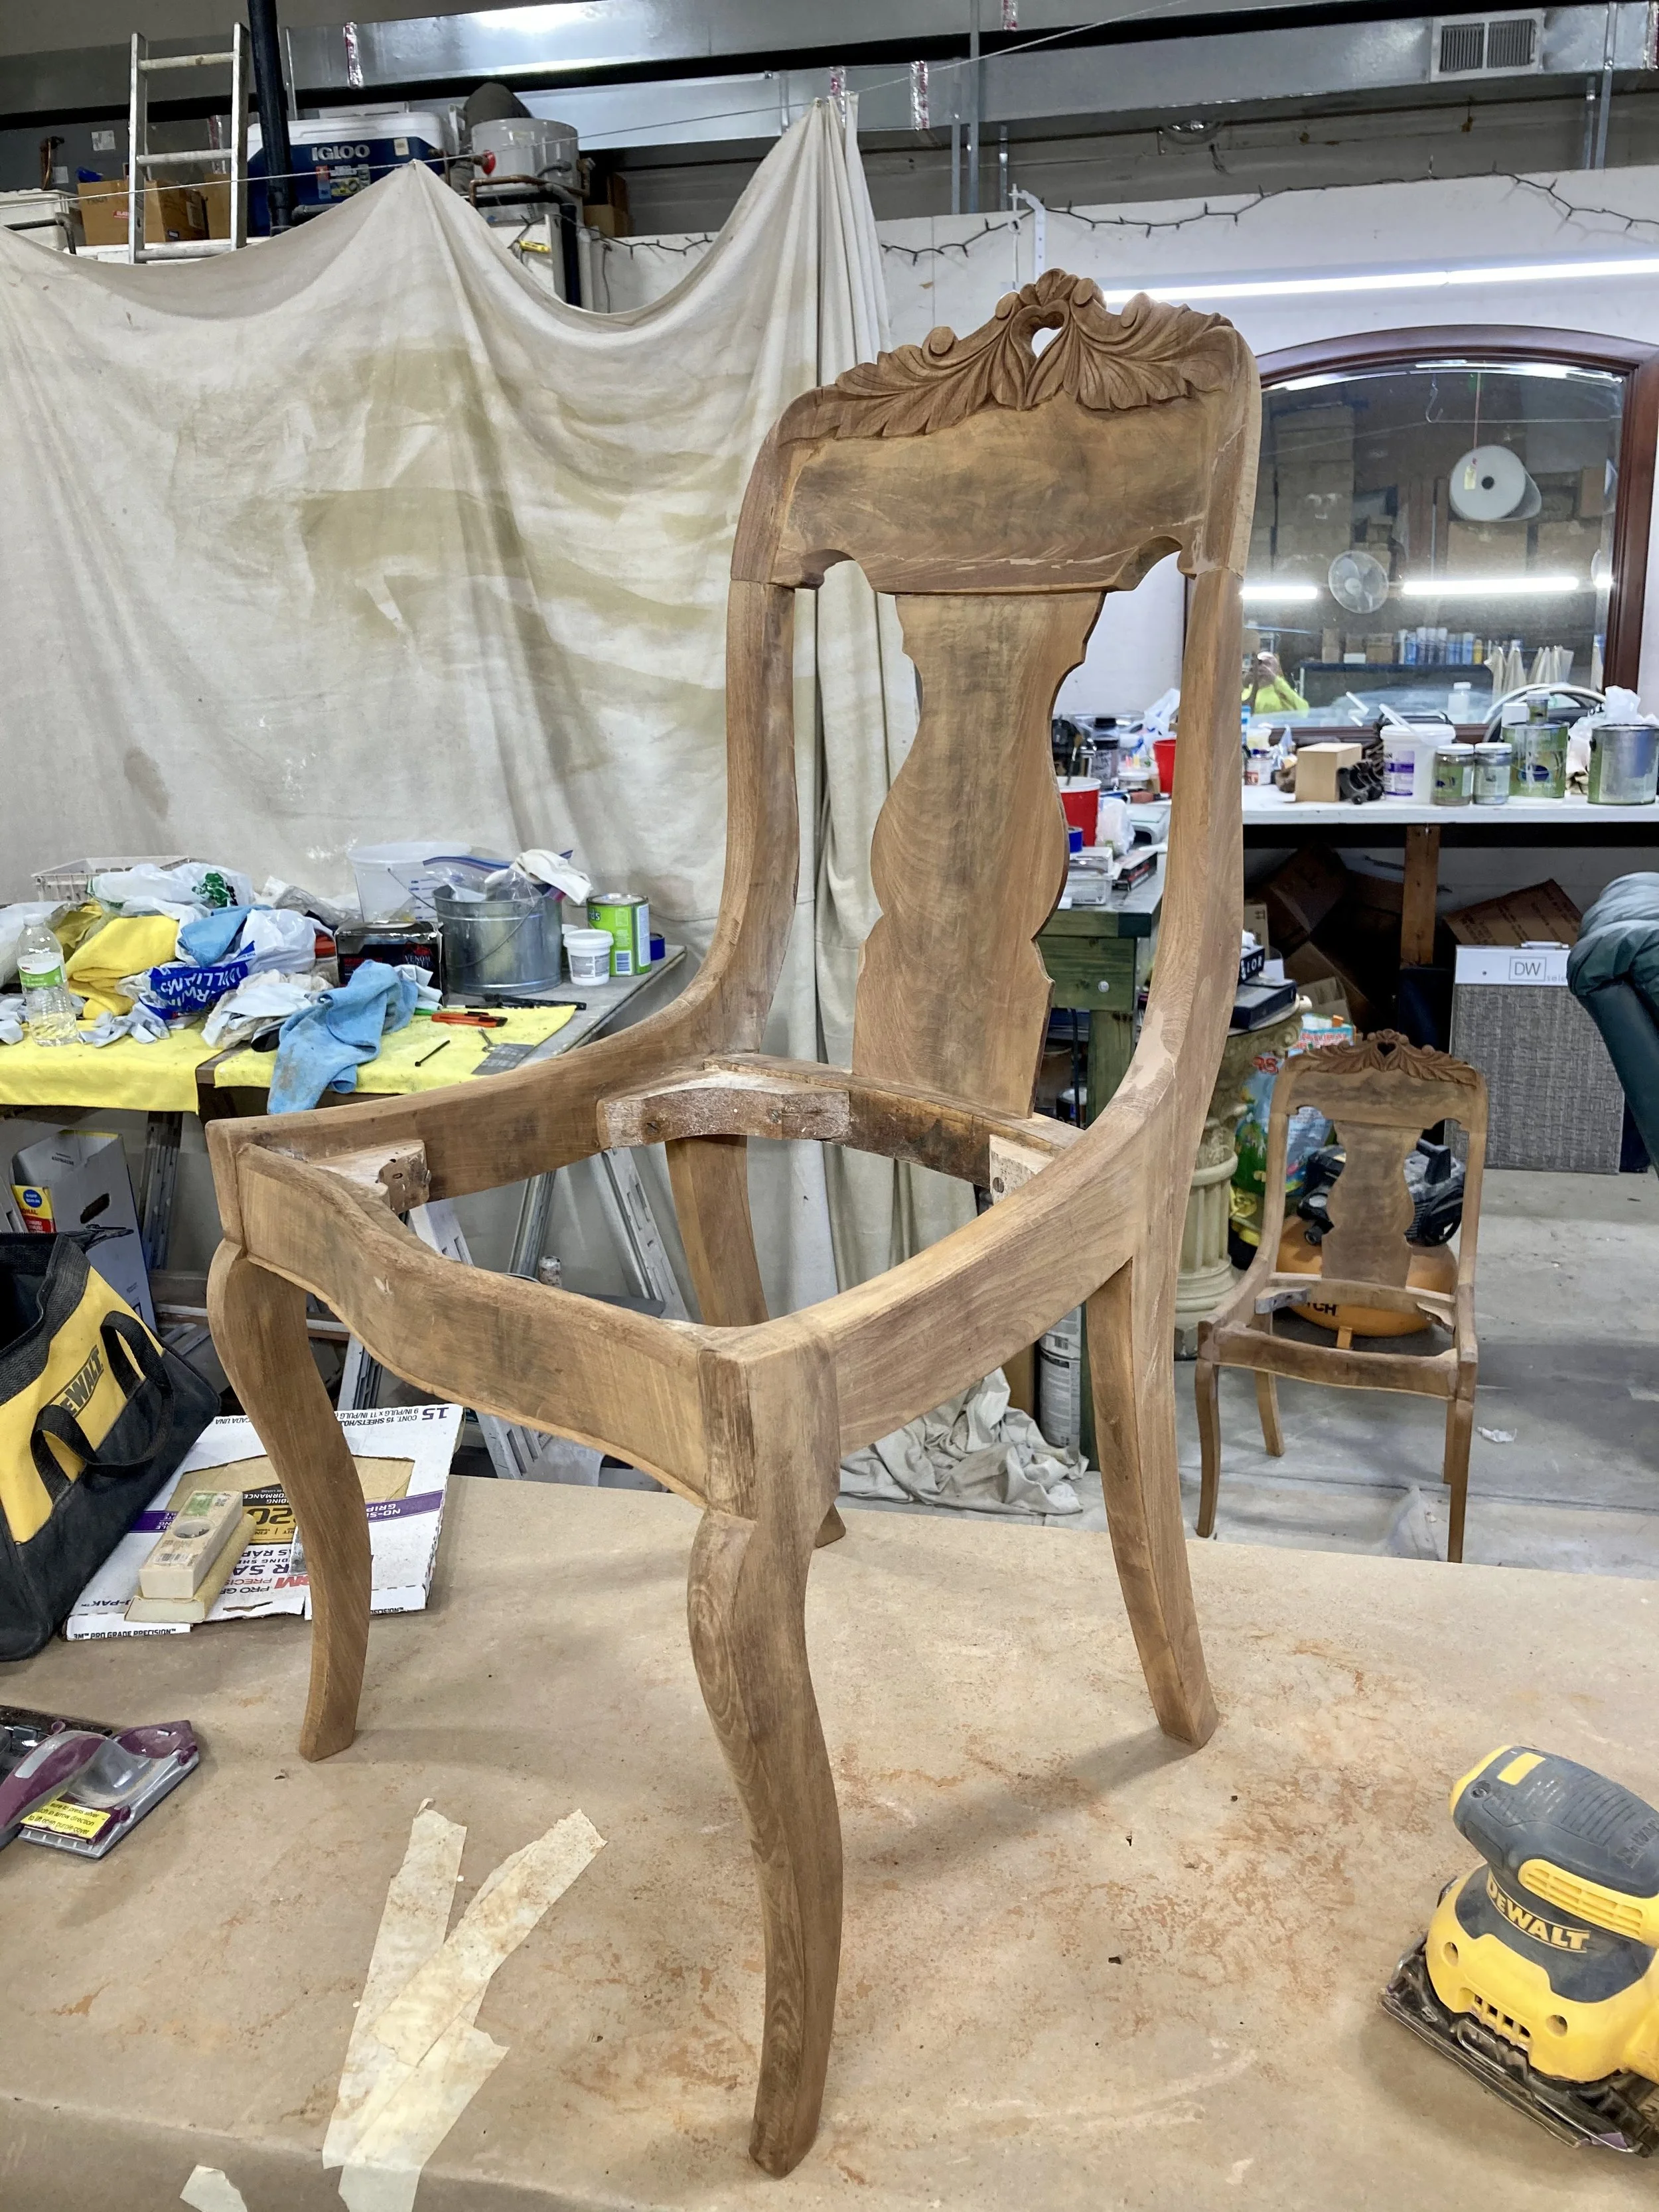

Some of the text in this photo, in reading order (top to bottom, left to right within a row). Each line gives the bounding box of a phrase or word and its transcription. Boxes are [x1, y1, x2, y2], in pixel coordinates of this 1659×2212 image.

[311, 144, 370, 161] IGLOO
[1514, 962, 1541, 976] DW
[60, 1347, 104, 1418] EWALT
[422, 1407, 449, 1420] 15
[366, 1503, 396, 1512] GRIP
[366, 1509, 401, 1518] NO-S
[70, 1814, 94, 1826] direction
[55, 1820, 74, 1831] purple
[73, 1826, 90, 1835] cover
[1486, 1870, 1590, 1949] DEWALT
